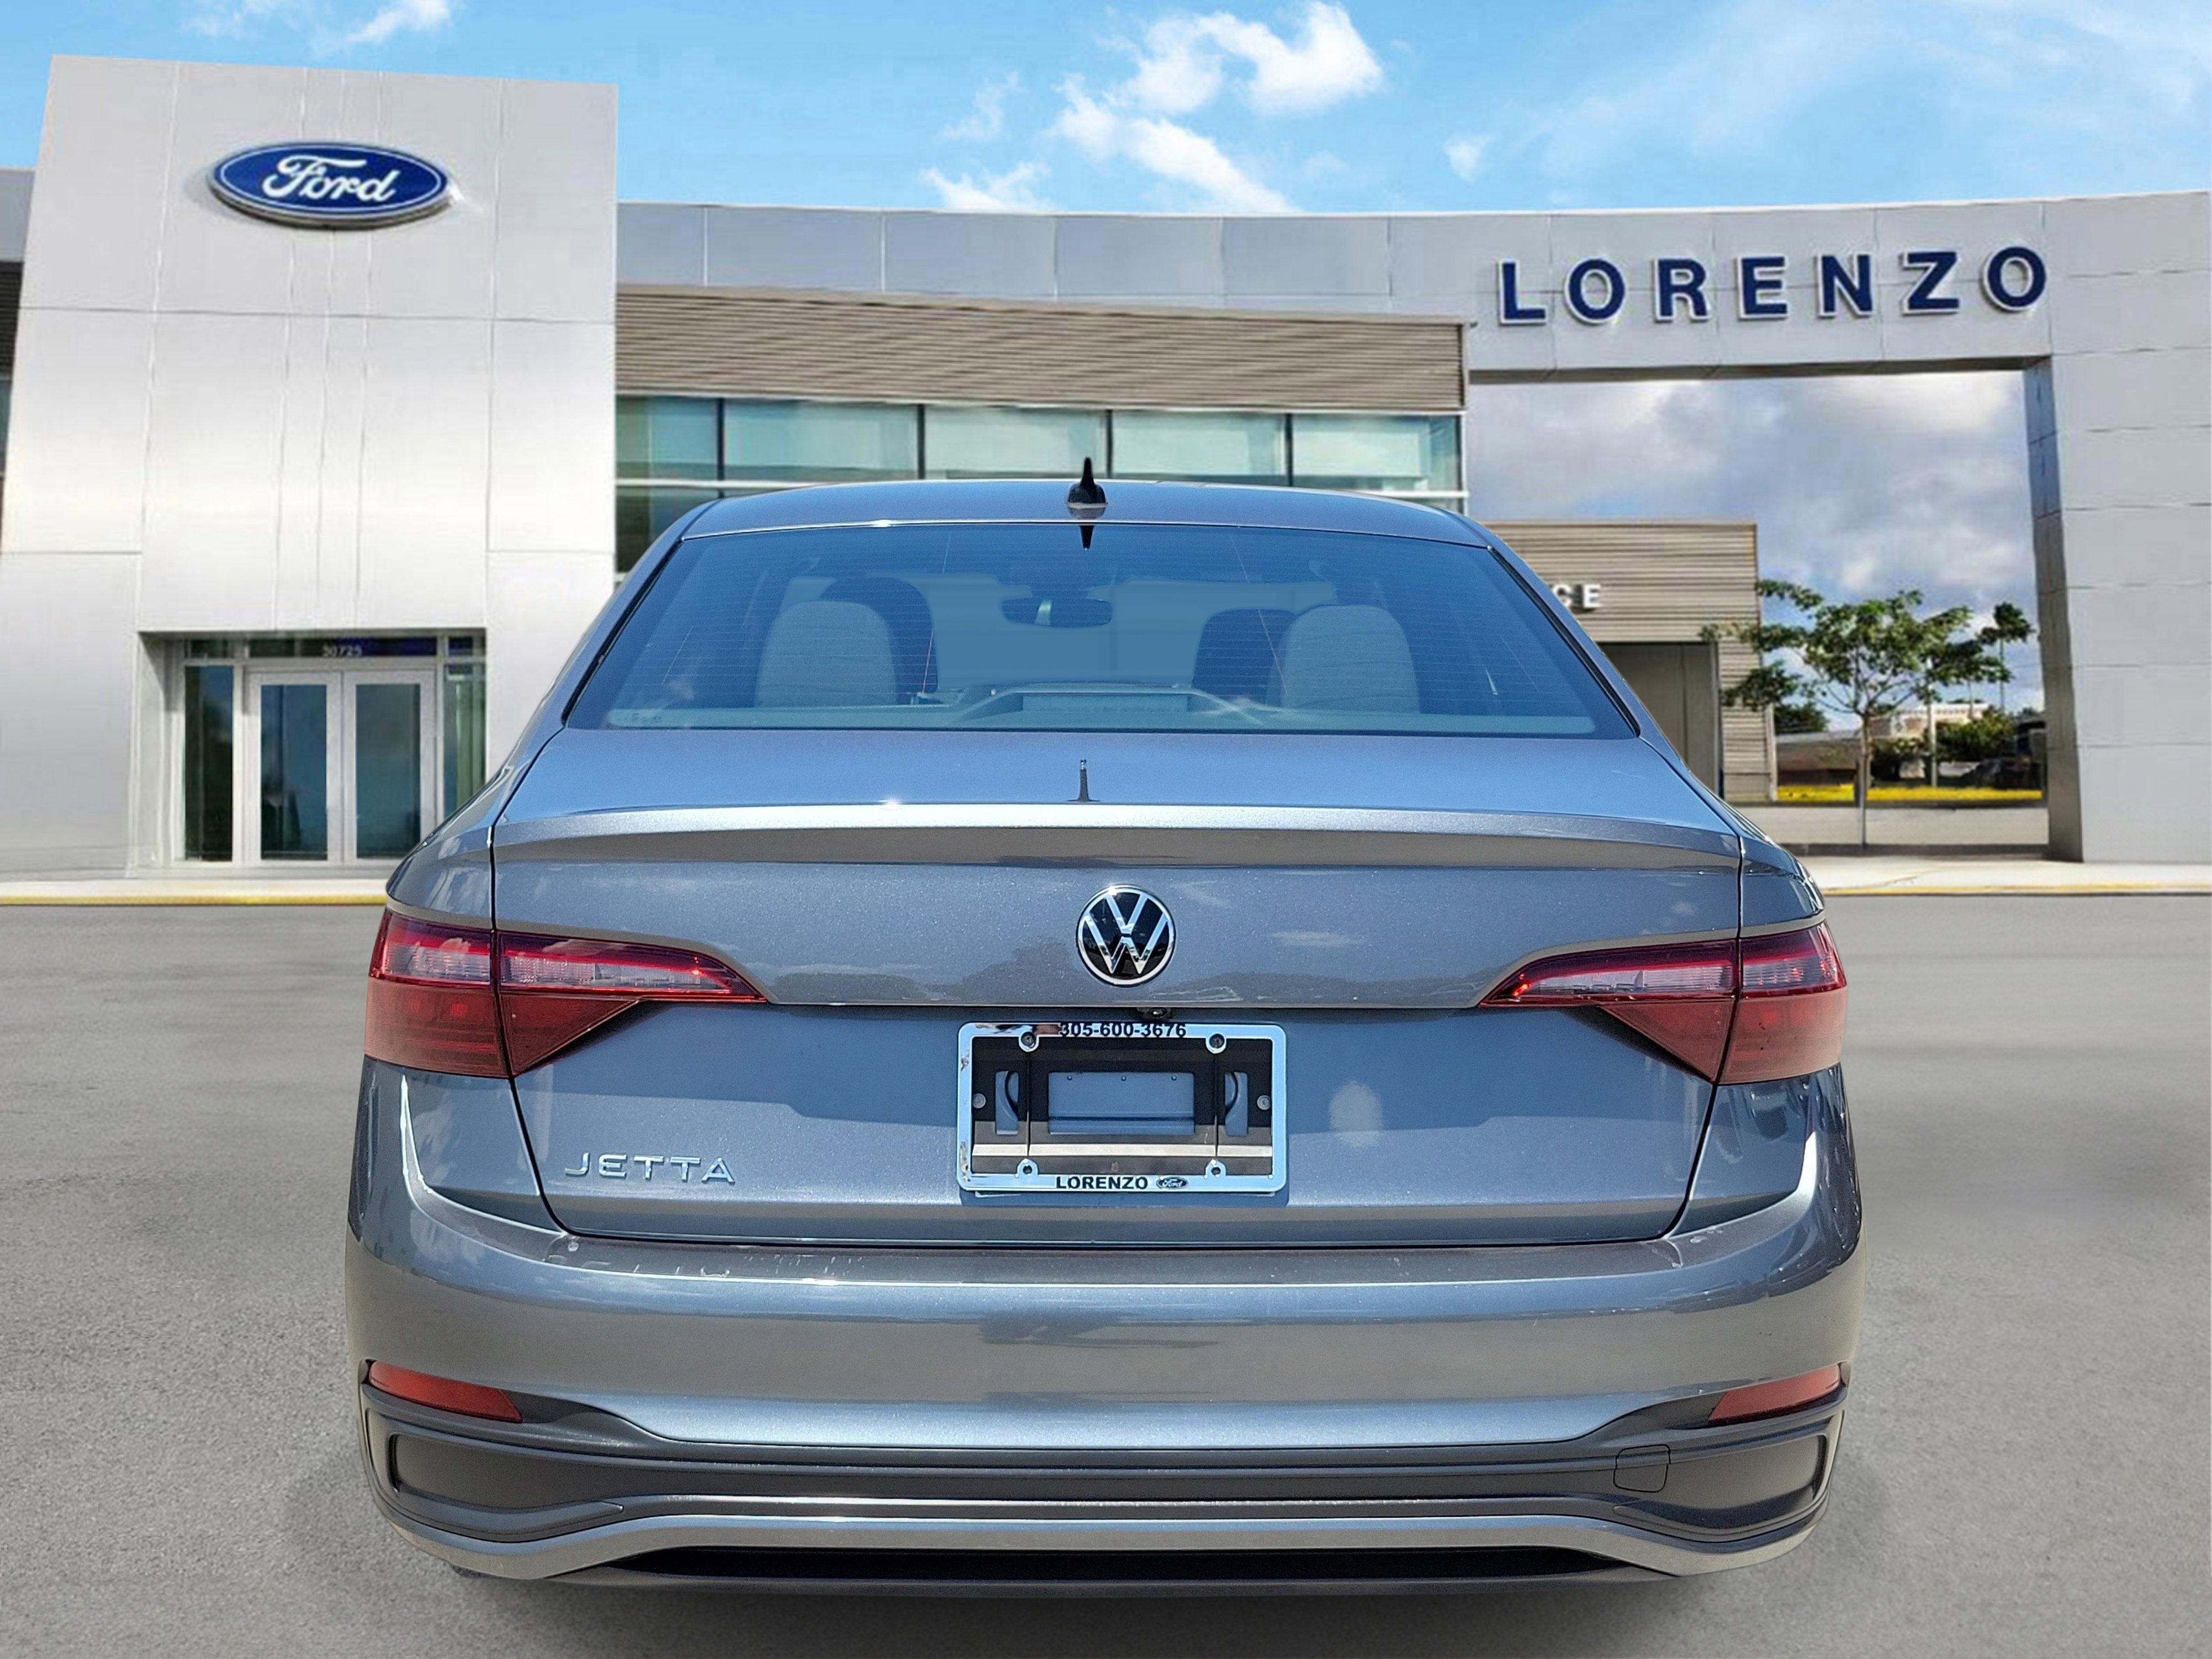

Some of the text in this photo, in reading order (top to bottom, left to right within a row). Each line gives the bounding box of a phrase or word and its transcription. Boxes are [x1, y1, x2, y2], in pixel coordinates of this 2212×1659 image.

[262, 154, 401, 202] Ford
[1497, 245, 2047, 324] LORENZO
[1060, 1023, 1187, 1037] 305-600-3676
[564, 1151, 736, 1185] JETTA
[1056, 1176, 1183, 1190] LORENZO Ford
